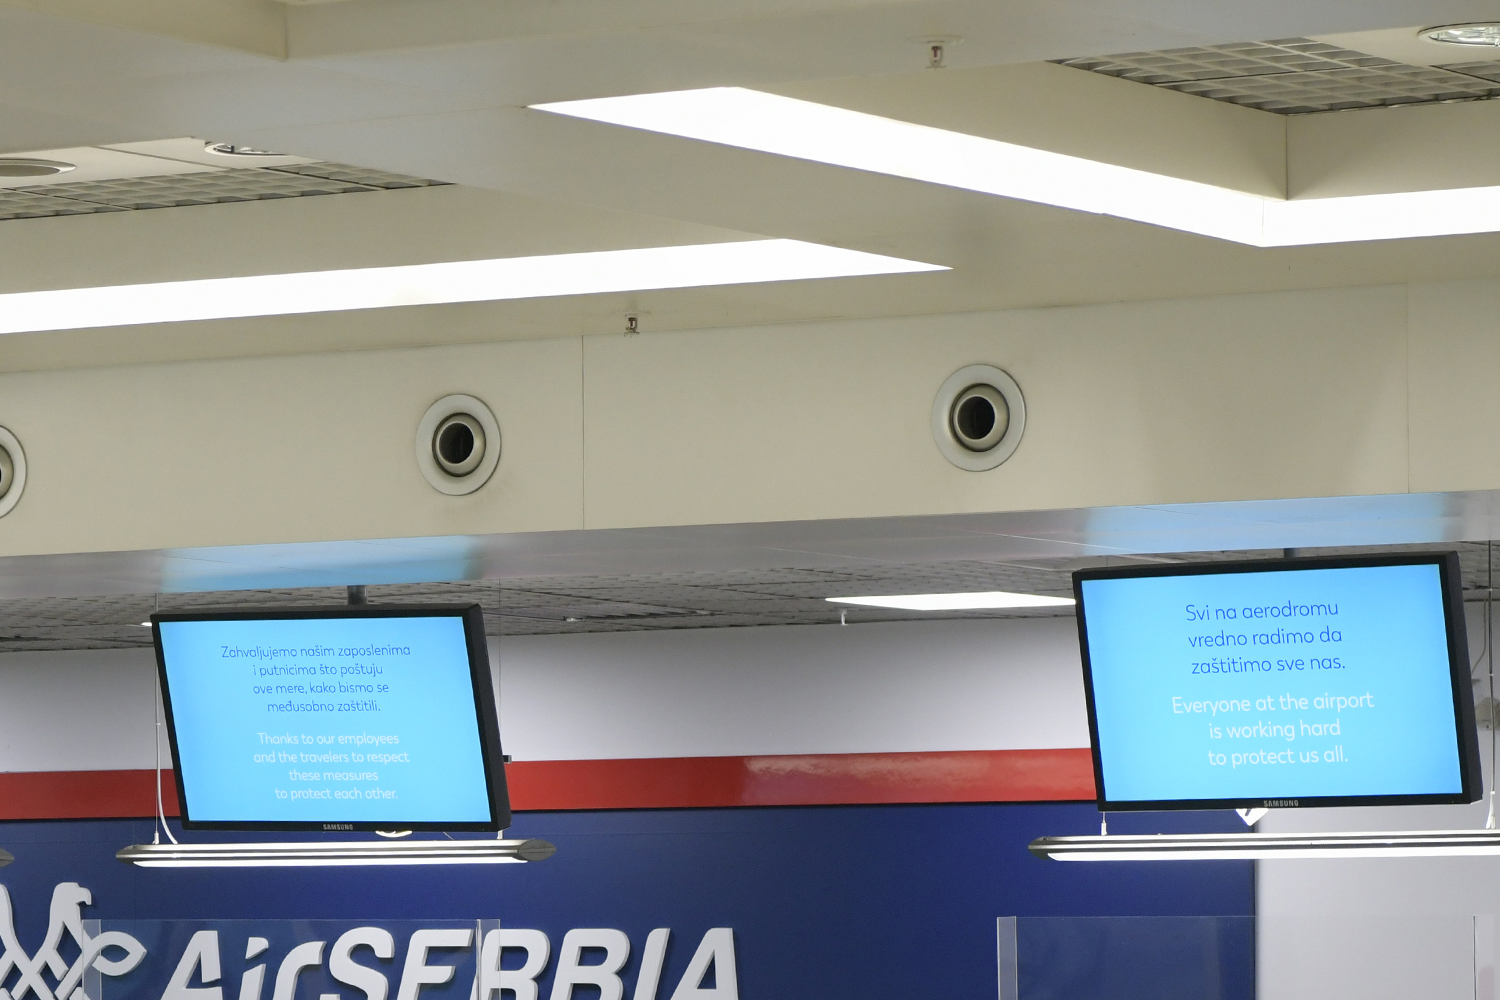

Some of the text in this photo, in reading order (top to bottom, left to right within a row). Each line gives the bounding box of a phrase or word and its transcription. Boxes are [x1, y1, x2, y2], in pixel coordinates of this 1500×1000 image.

[1186, 601, 1338, 621] Svi na aerodromu
[1188, 627, 1342, 648] vredno radimo da
[221, 644, 410, 660] Zahvaljujemo našim zaposlenima
[260, 664, 316, 678] putnicima
[320, 662, 337, 675] što
[341, 663, 383, 678] poštuju
[1192, 655, 1346, 675] zaštitimo sve nas.
[253, 681, 389, 696] ove mere, kako bismo se
[267, 700, 381, 712] međusobno zaštitili.
[1173, 692, 1374, 716] Everyone at the airport
[1209, 718, 1340, 741] is working hard
[257, 732, 399, 747] Thanks to our employees
[254, 750, 409, 765] and the travelers to respect
[1208, 745, 1348, 769] to protect us all.
[289, 769, 378, 781] these measures
[276, 787, 398, 801] to protect each other.
